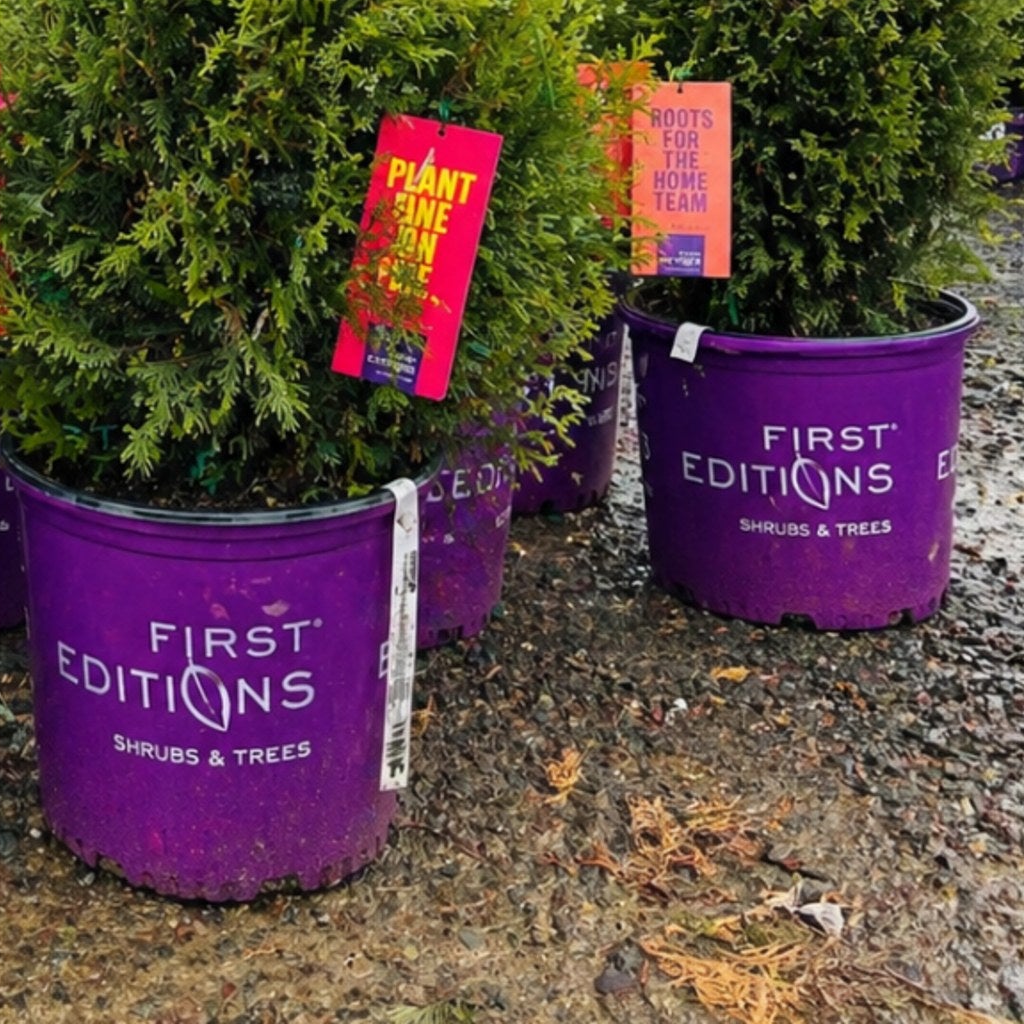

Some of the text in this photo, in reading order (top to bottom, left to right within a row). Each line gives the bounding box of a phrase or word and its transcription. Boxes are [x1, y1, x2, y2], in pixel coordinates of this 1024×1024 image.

[651, 108, 714, 129] ROOTS
[663, 130, 699, 149] FOR
[663, 150, 699, 170] THE
[387, 156, 478, 205] PLANT
[653, 171, 707, 191] HOME
[653, 192, 707, 213] TEAM
[682, 451, 894, 510] EDITIONS
[739, 518, 893, 537] SHRUBS & TREES
[57, 640, 316, 732] EDITIONS
[113, 733, 312, 767] SHRUBS & TREES
